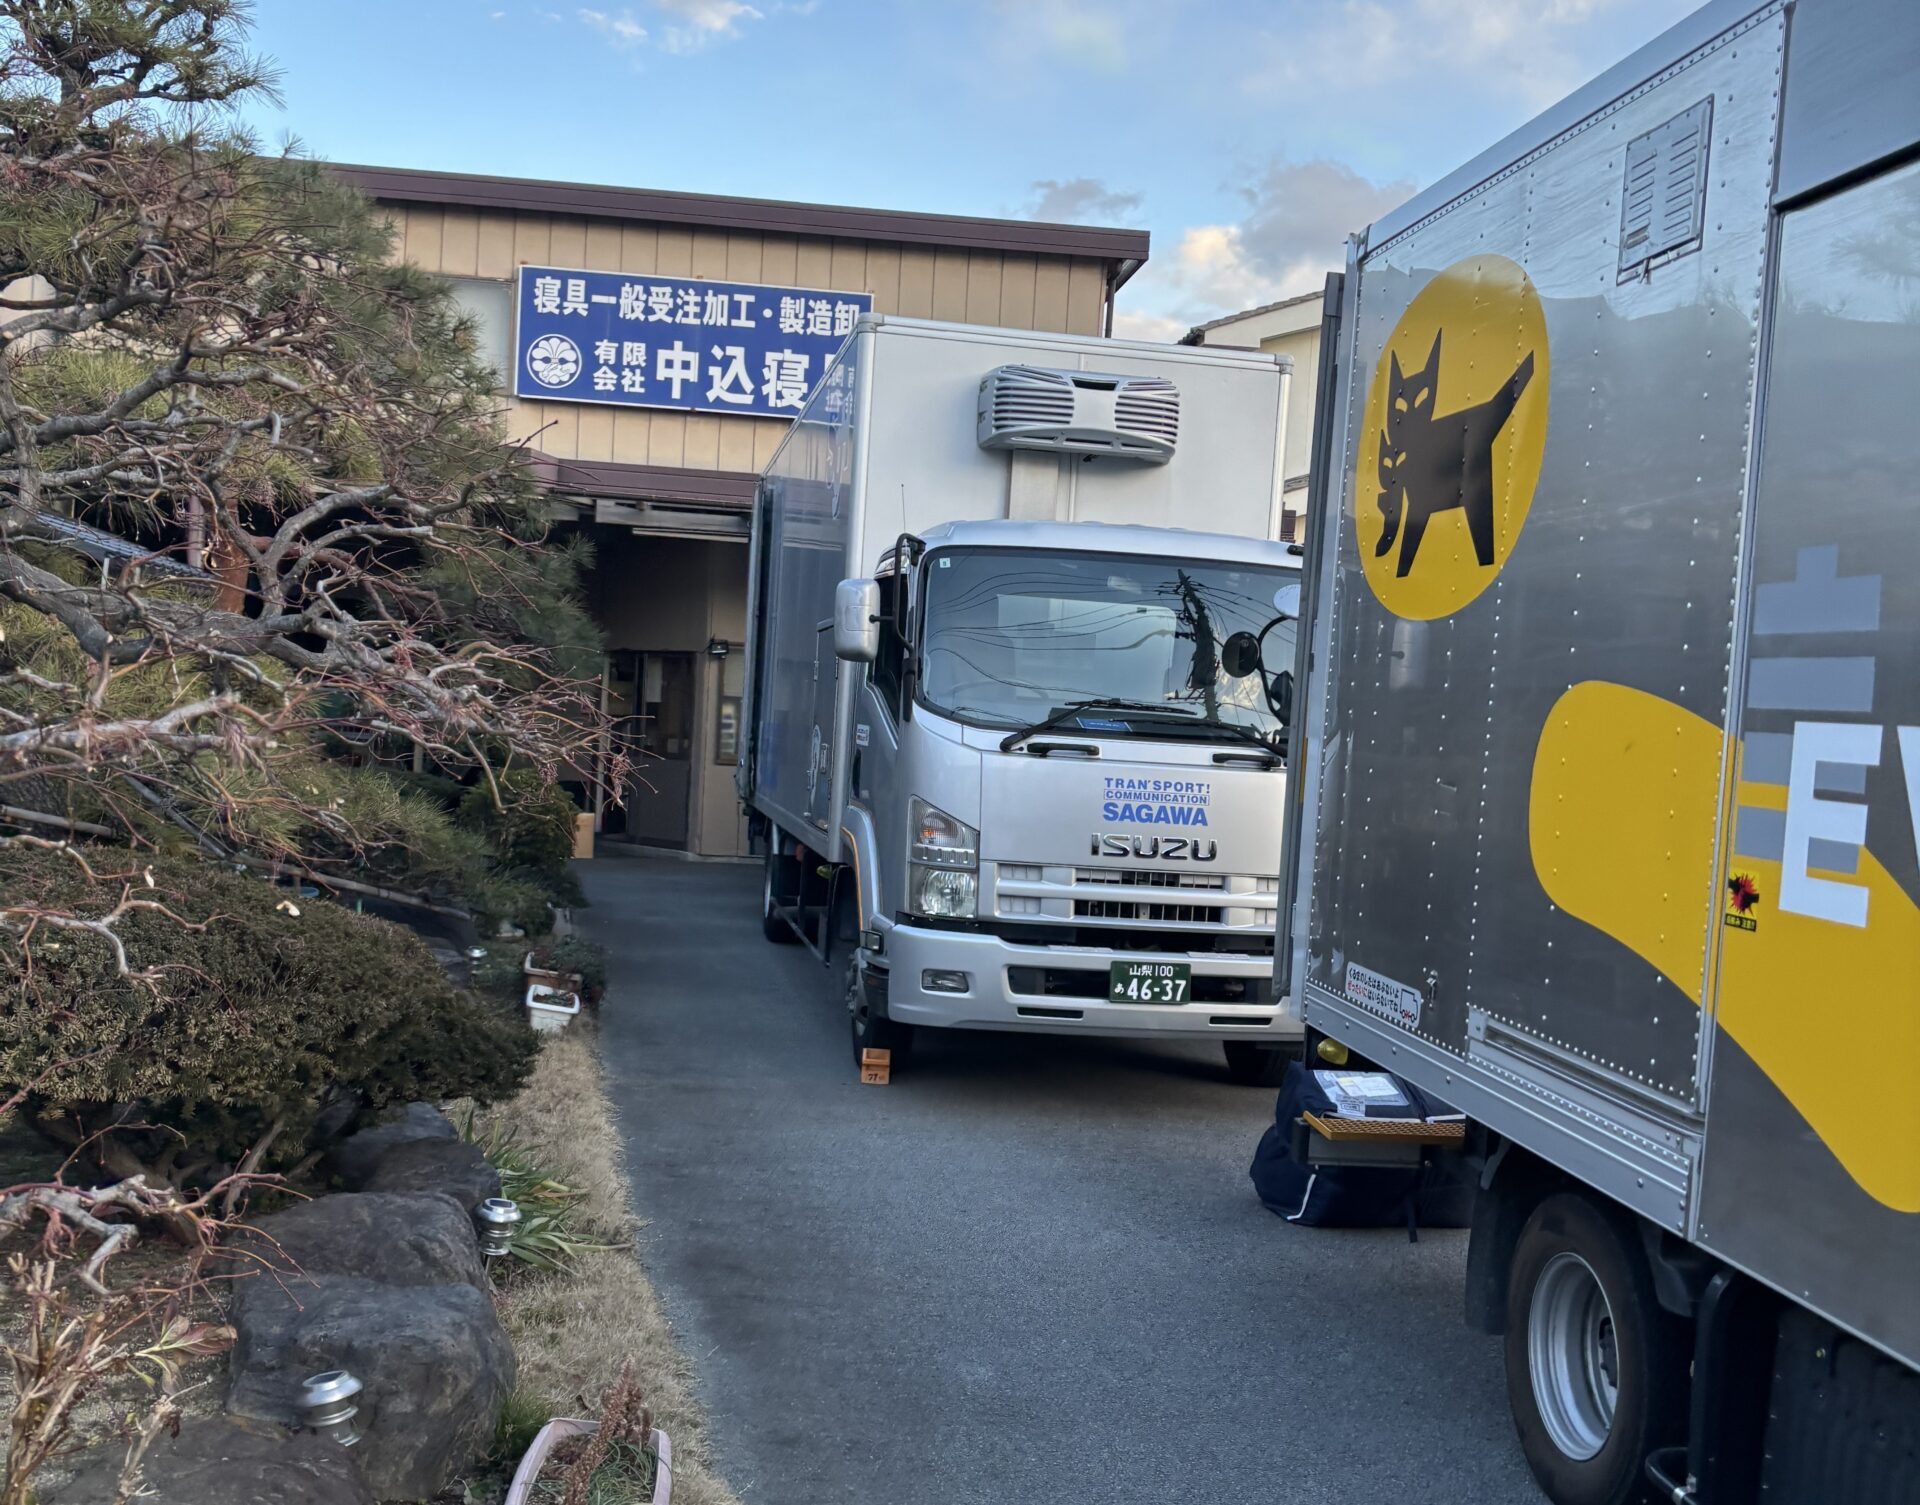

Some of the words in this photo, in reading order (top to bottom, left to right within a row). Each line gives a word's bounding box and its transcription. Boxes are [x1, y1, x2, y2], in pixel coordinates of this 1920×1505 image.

[534, 275, 860, 337] 寝具一般受注加工・製造卸
[594, 339, 647, 367] 有限
[592, 367, 646, 394] 会社
[655, 340, 836, 408] 中込寝
[1105, 790, 1207, 804] COMMUNICATION
[1103, 802, 1208, 826] SAGAWA
[1778, 721, 1920, 928] E
[1091, 832, 1218, 862] ISUZU
[1129, 964, 1152, 976] 山梨
[1155, 965, 1174, 977] 100
[1114, 982, 1124, 994] あ
[1127, 977, 1187, 1002] 46-37
